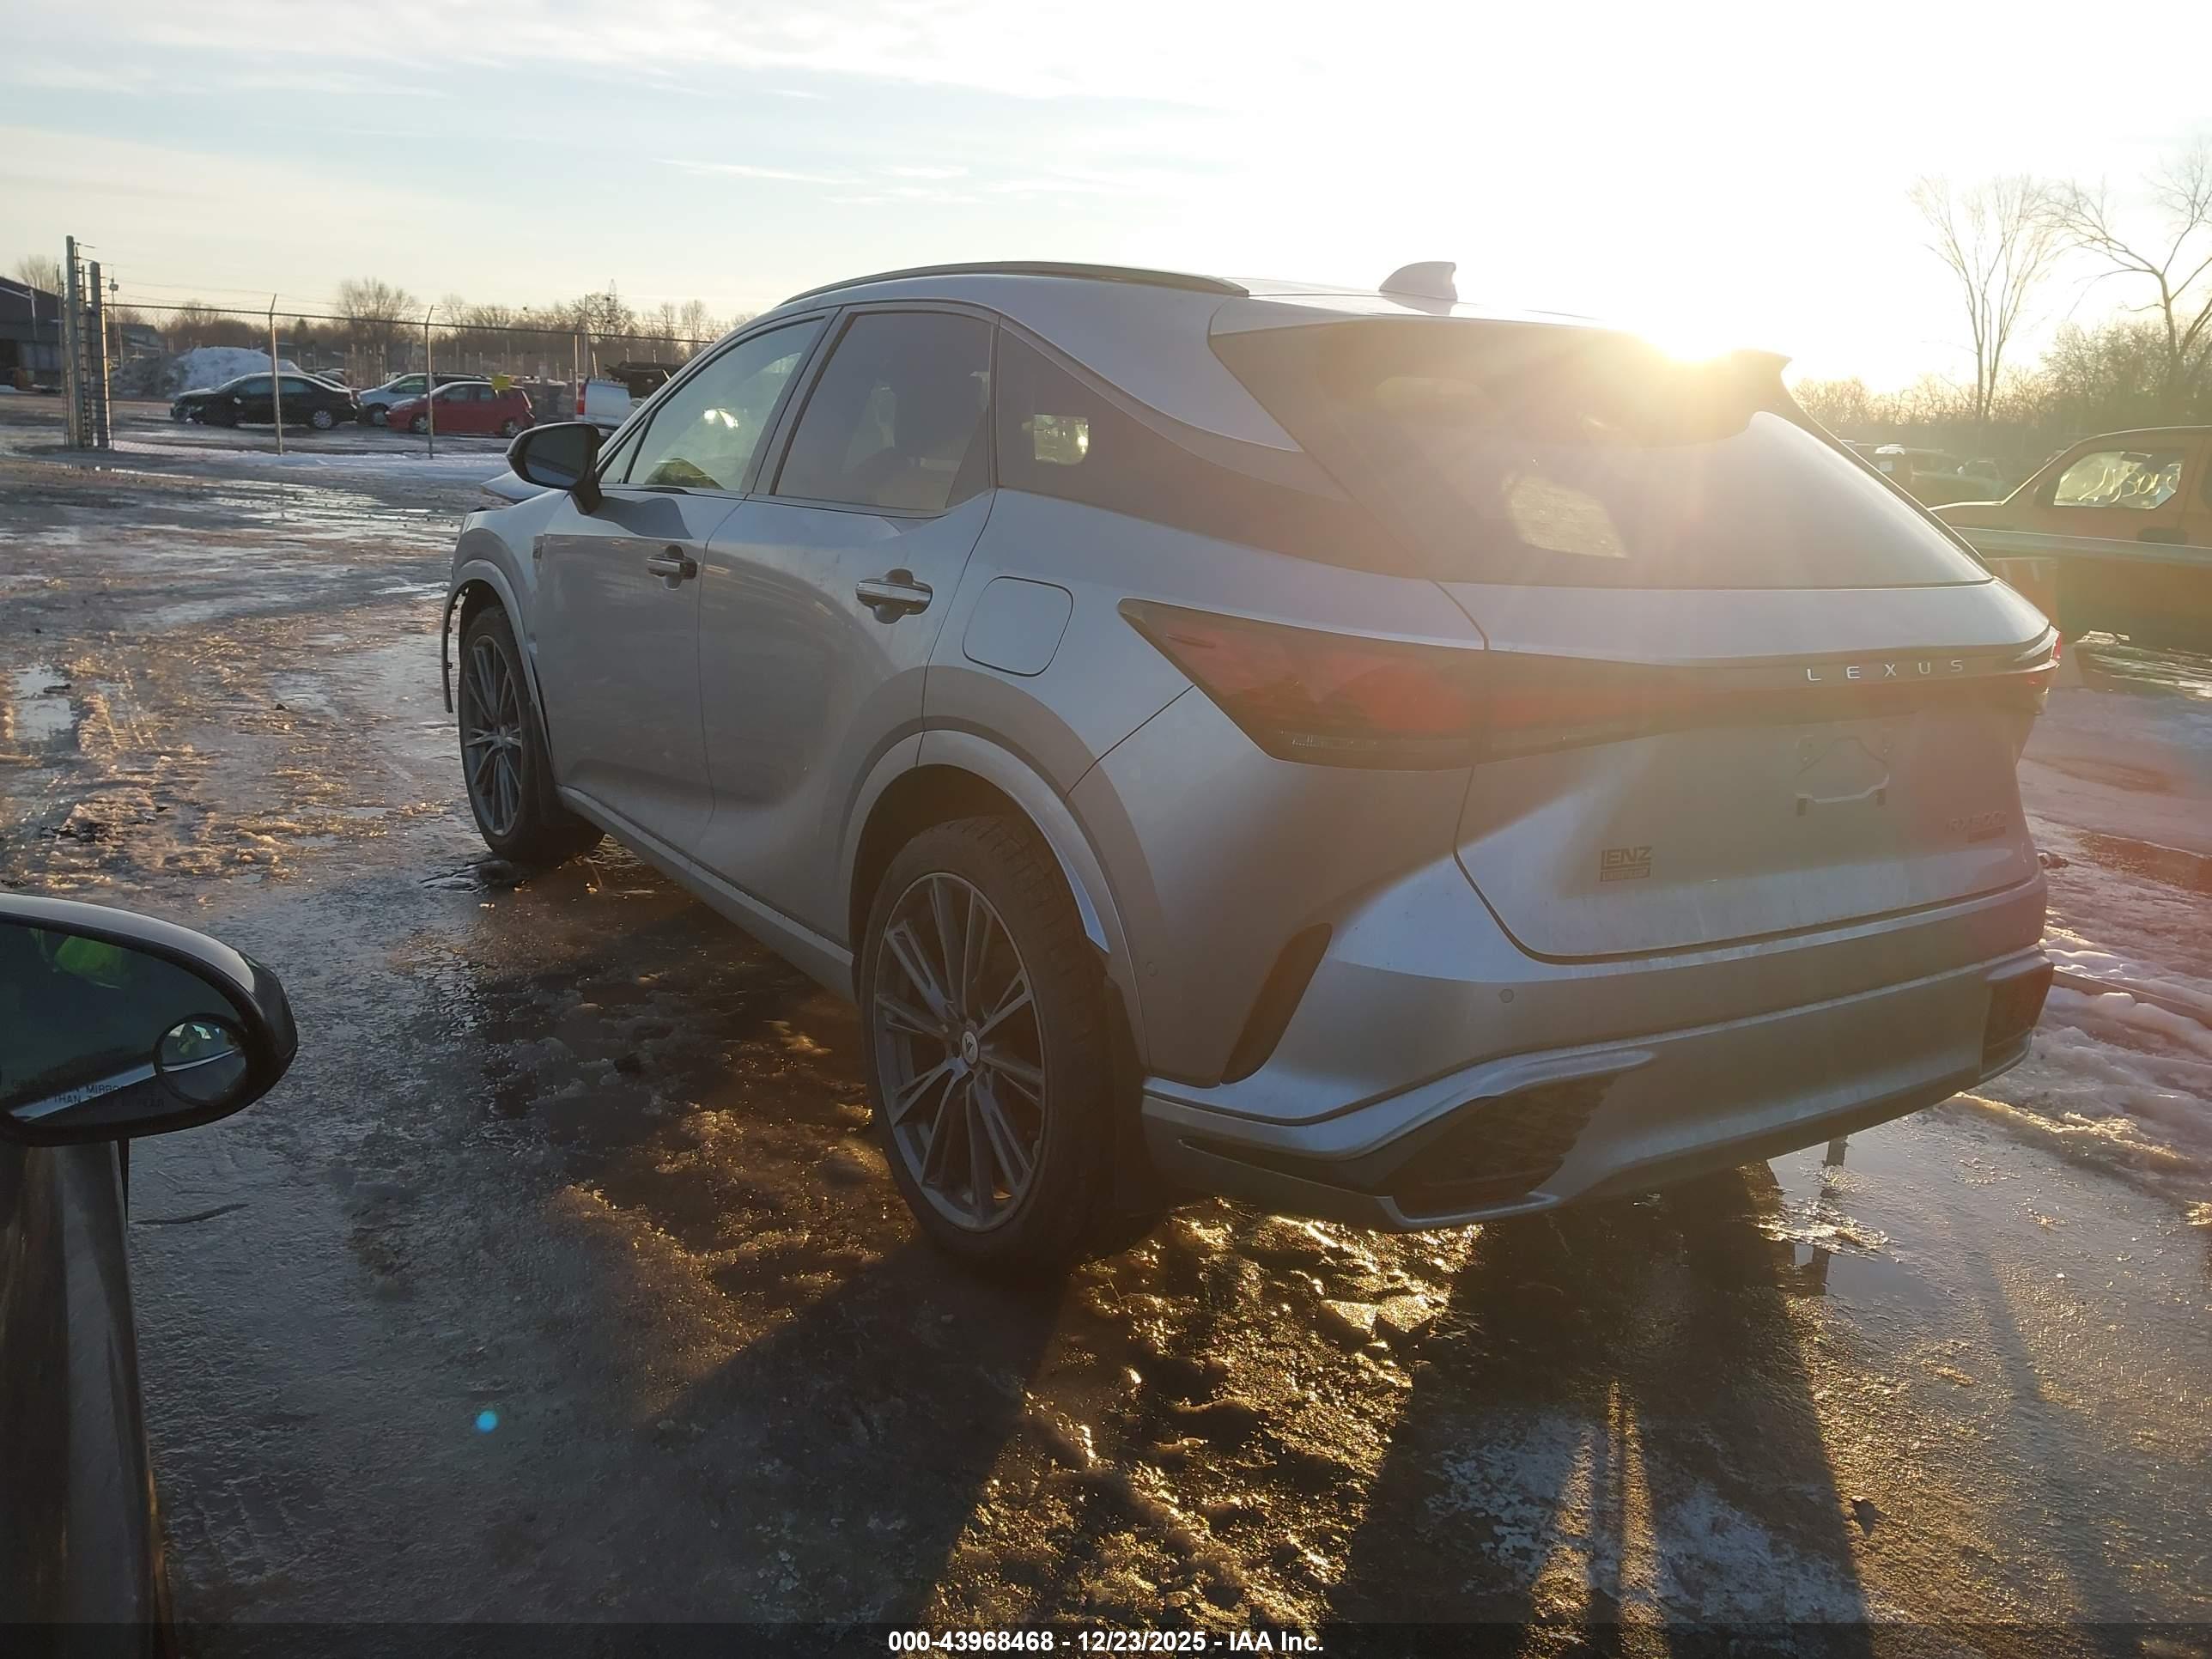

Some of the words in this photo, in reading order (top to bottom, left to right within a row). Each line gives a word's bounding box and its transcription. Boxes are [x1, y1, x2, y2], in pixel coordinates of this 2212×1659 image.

[1807, 660, 1963, 681] LEXUS
[1601, 846, 1651, 869] LENZ
[86, 1085, 128, 1094] MIRRO
[54, 1094, 82, 1105] THAN
